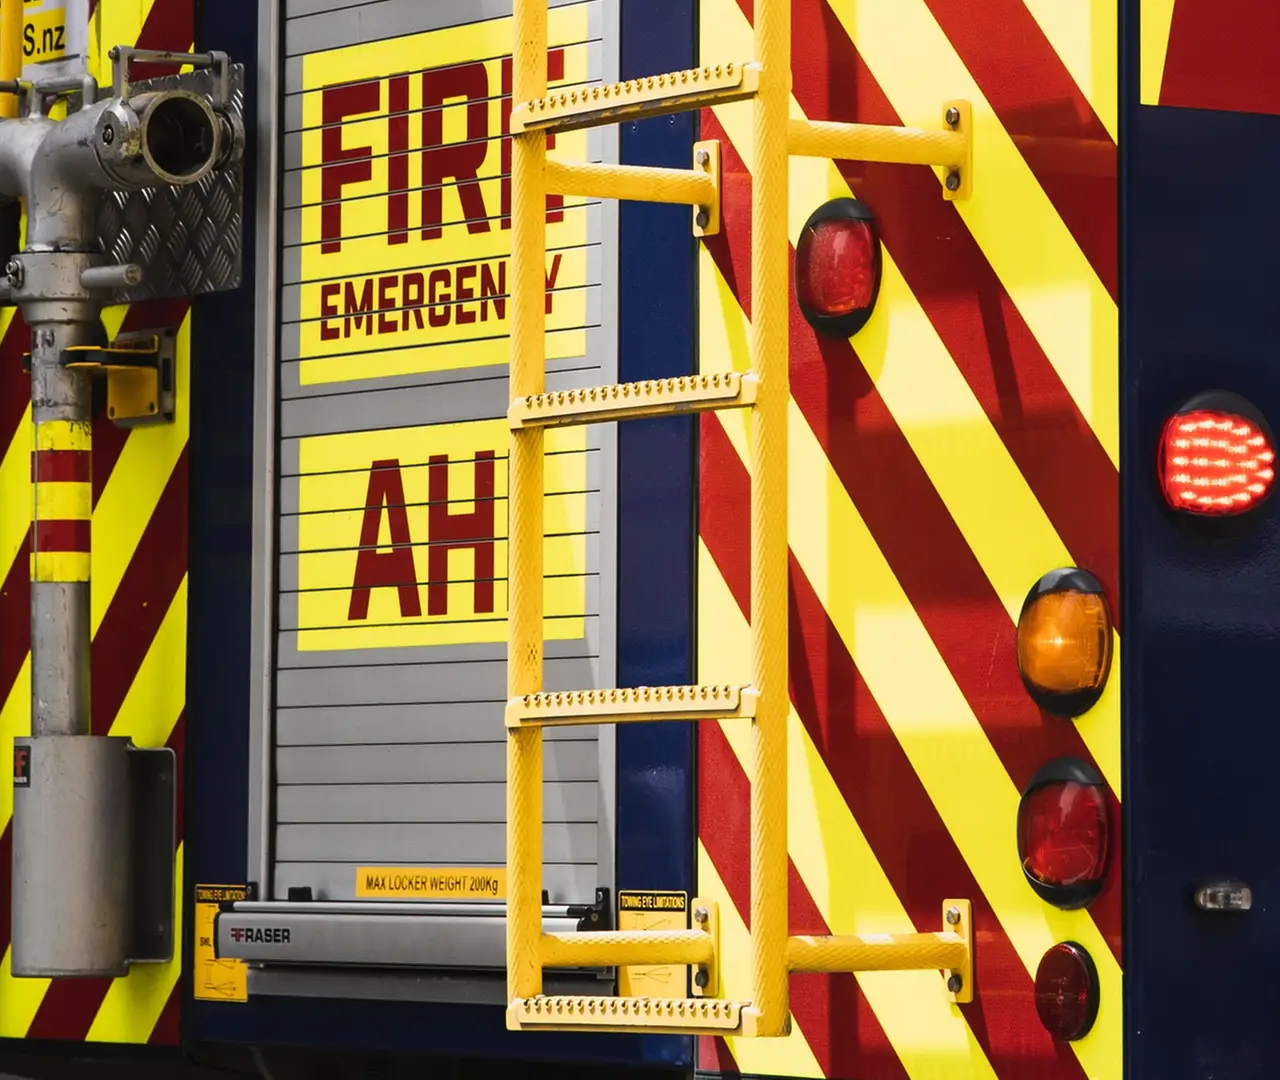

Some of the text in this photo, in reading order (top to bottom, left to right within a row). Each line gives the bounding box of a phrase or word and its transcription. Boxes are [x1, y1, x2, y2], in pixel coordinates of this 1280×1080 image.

[321, 254, 562, 342] EMERGENY
[347, 448, 509, 620] AH
[366, 875, 499, 896] MAX LOCKER WEIGHT 200Kg
[231, 927, 291, 943] FRASER
